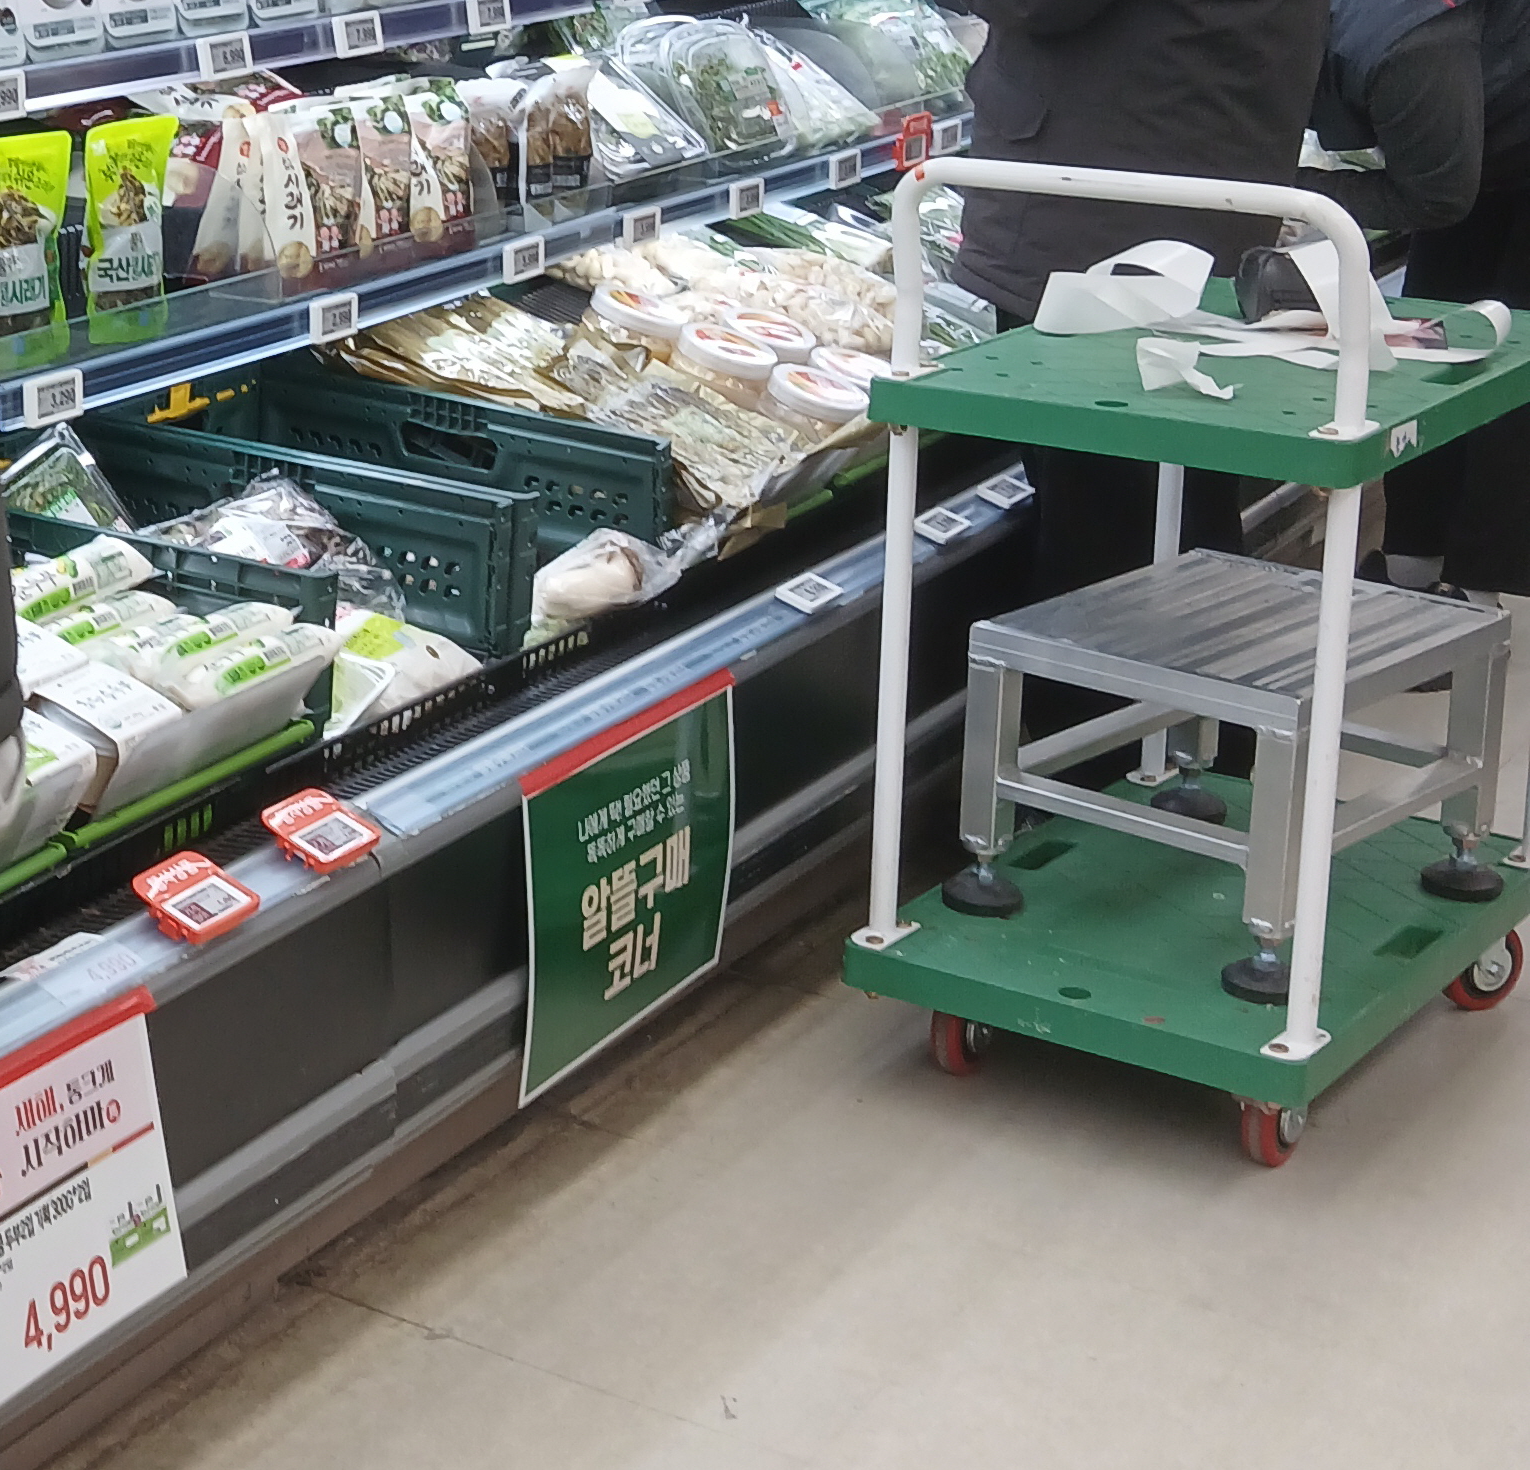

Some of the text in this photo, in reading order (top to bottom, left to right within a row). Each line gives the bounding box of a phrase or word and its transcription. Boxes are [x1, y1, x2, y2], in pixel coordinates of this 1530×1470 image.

[96, 255, 132, 285] 국산
[576, 811, 610, 845] 나에게
[623, 778, 663, 819] 필요했던
[662, 770, 673, 796] 그
[673, 757, 692, 789] 상품
[626, 810, 655, 844] 구매할
[655, 803, 666, 826] 수
[666, 792, 686, 821] 있는
[580, 824, 692, 953] 알뜰구매
[603, 910, 662, 1002] 코너
[14, 1084, 65, 1137] 새해,
[20, 1108, 106, 1179] 시작하마
[22, 1254, 111, 1352] 4,990
